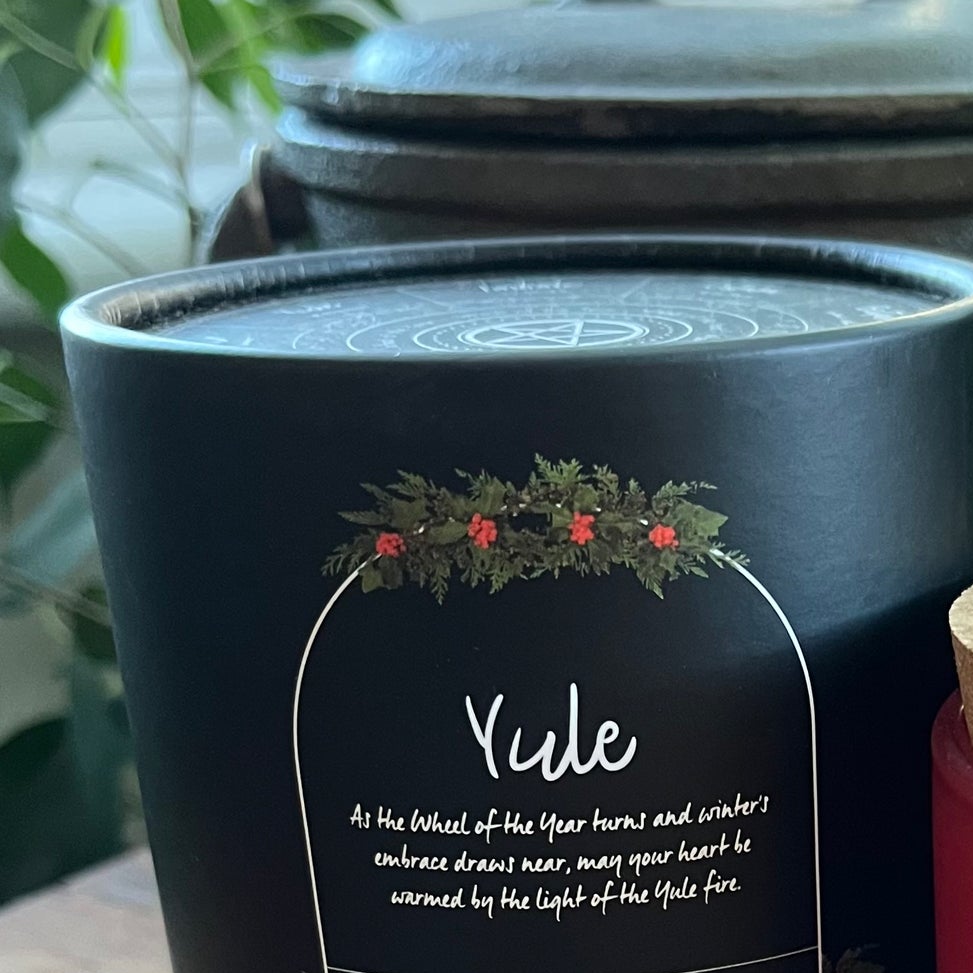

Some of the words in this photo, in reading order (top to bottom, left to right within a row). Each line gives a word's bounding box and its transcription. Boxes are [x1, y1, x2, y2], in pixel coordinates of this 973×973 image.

[465, 682, 637, 782] Yule
[349, 803, 371, 829] As
[376, 805, 406, 832] the
[410, 808, 471, 836] Wheel
[474, 807, 503, 845] of
[503, 810, 535, 835] the
[539, 811, 588, 844] Year
[592, 807, 647, 832] turns
[652, 801, 694, 828] and
[697, 792, 770, 824] winter's
[374, 843, 449, 872] embrace
[453, 850, 515, 874] draws
[521, 856, 571, 876] near,
[576, 854, 623, 879] may
[628, 850, 674, 877] your
[677, 832, 731, 862] heart
[734, 828, 752, 854] be
[390, 887, 466, 909] warmed
[470, 884, 494, 920] by
[500, 886, 531, 910] the
[535, 884, 588, 922] light
[590, 880, 619, 916] of
[619, 879, 650, 905] the
[654, 876, 698, 911] Yule
[702, 868, 743, 905] fire.
